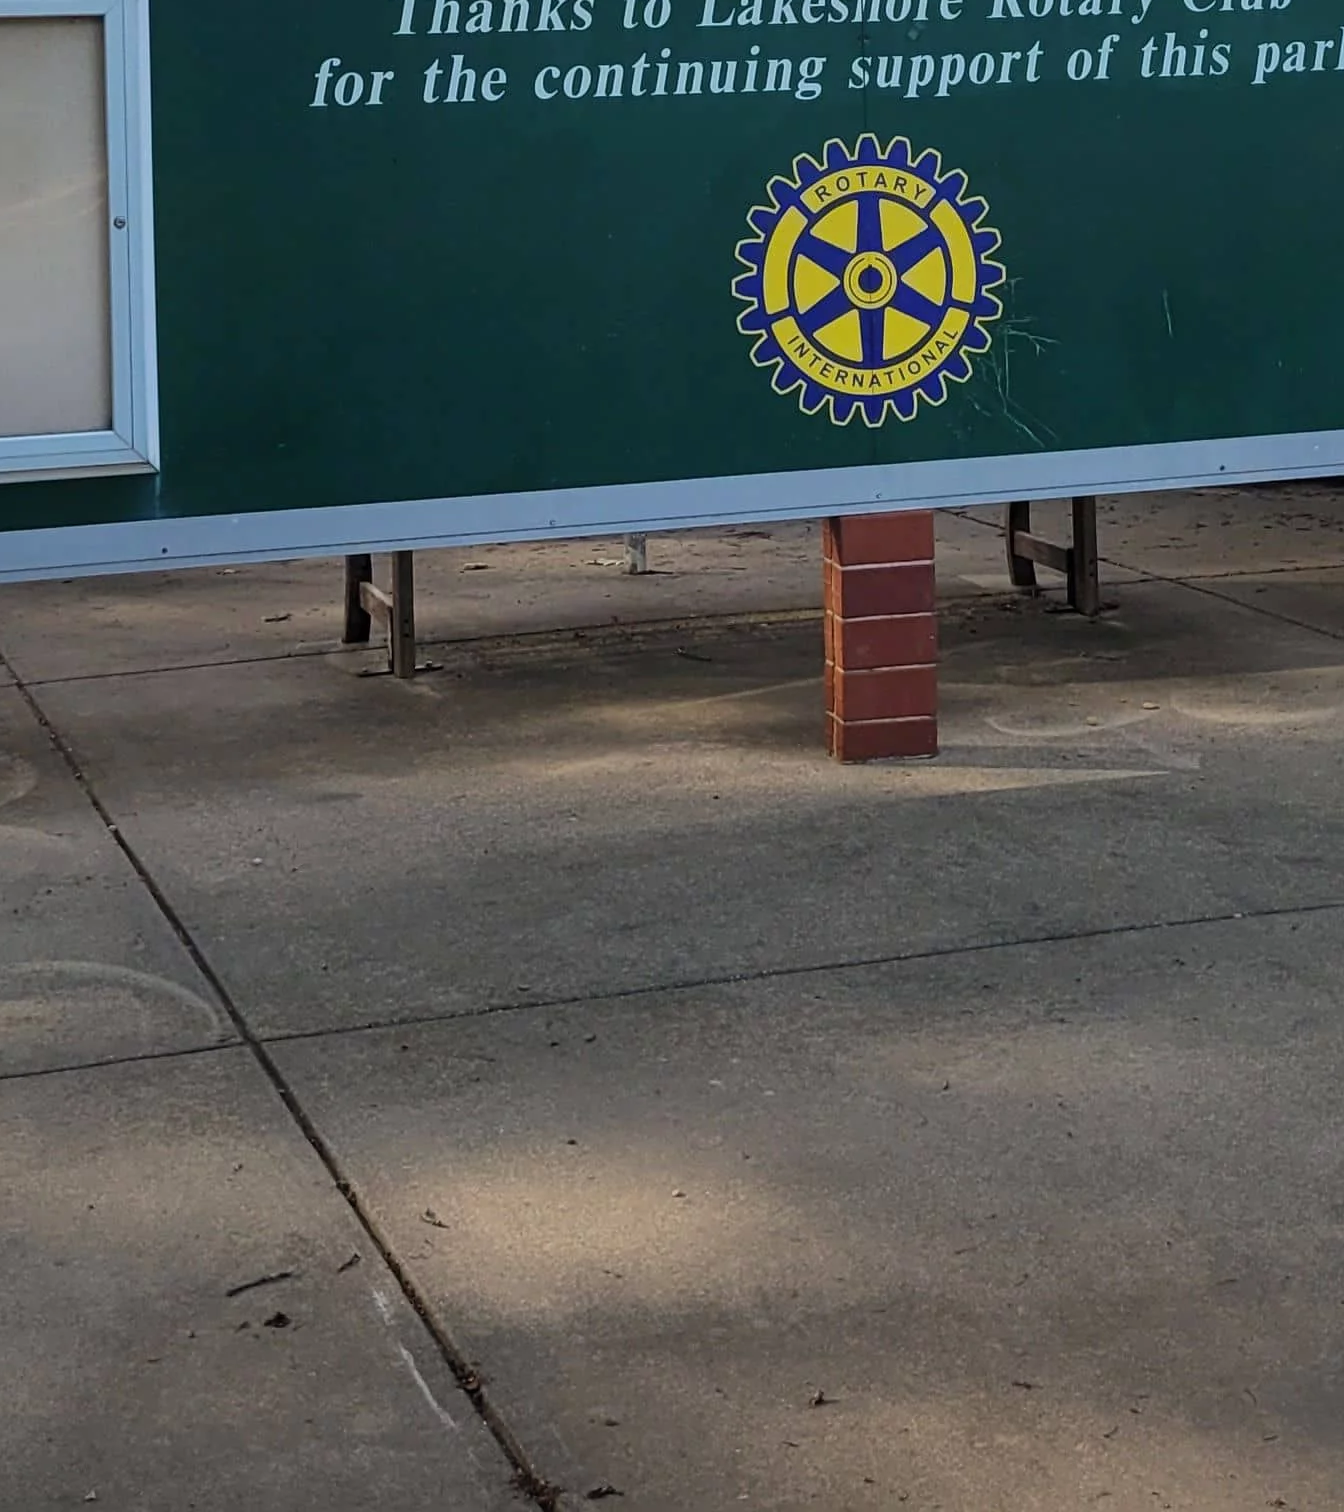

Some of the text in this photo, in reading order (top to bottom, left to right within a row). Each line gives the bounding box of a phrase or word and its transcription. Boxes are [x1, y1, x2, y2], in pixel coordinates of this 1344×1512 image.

[308, 56, 394, 107] for
[422, 54, 508, 103] the
[533, 44, 828, 101] continuing
[848, 39, 1044, 99] support
[1066, 33, 1121, 80] of
[1140, 28, 1232, 78] this
[814, 171, 927, 204] ROTARY
[786, 330, 960, 389] INTERNATIONAL
